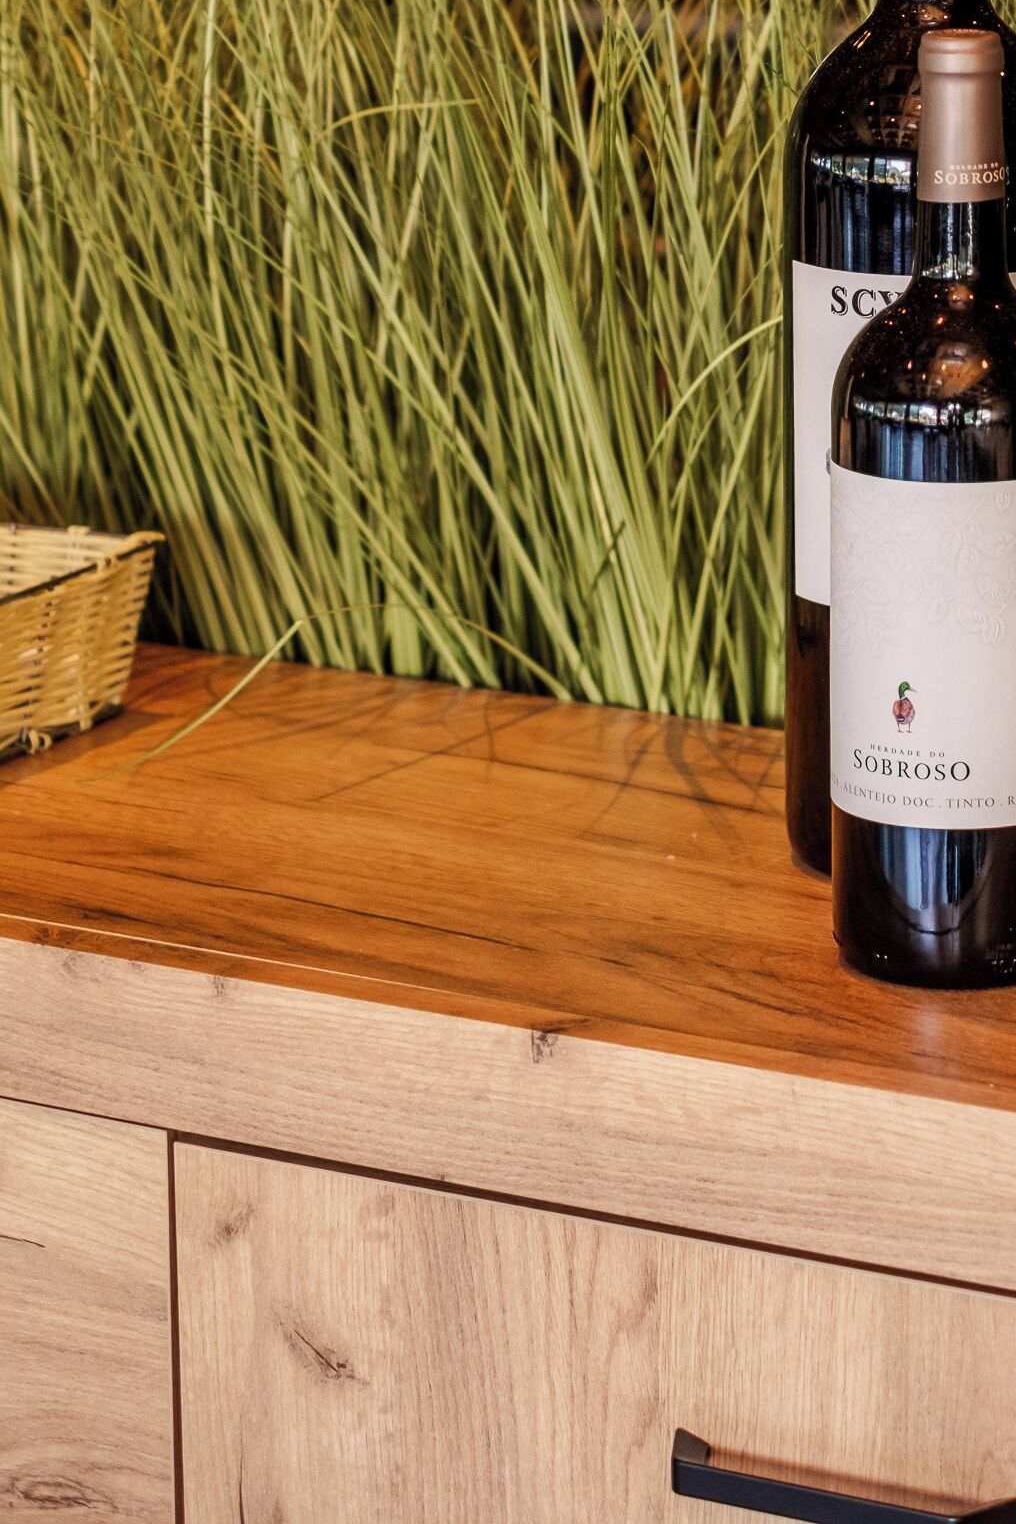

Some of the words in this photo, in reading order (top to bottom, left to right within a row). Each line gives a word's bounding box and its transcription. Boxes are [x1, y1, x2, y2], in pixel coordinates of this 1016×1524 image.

[934, 166, 1005, 185] SOBROSO
[870, 743, 920, 757] HERDADE
[929, 750, 945, 758] DO
[853, 748, 970, 782] SOBROSO
[843, 781, 896, 805] ALENTEJO
[903, 795, 934, 808] DOC
[945, 797, 995, 809] TINTO
